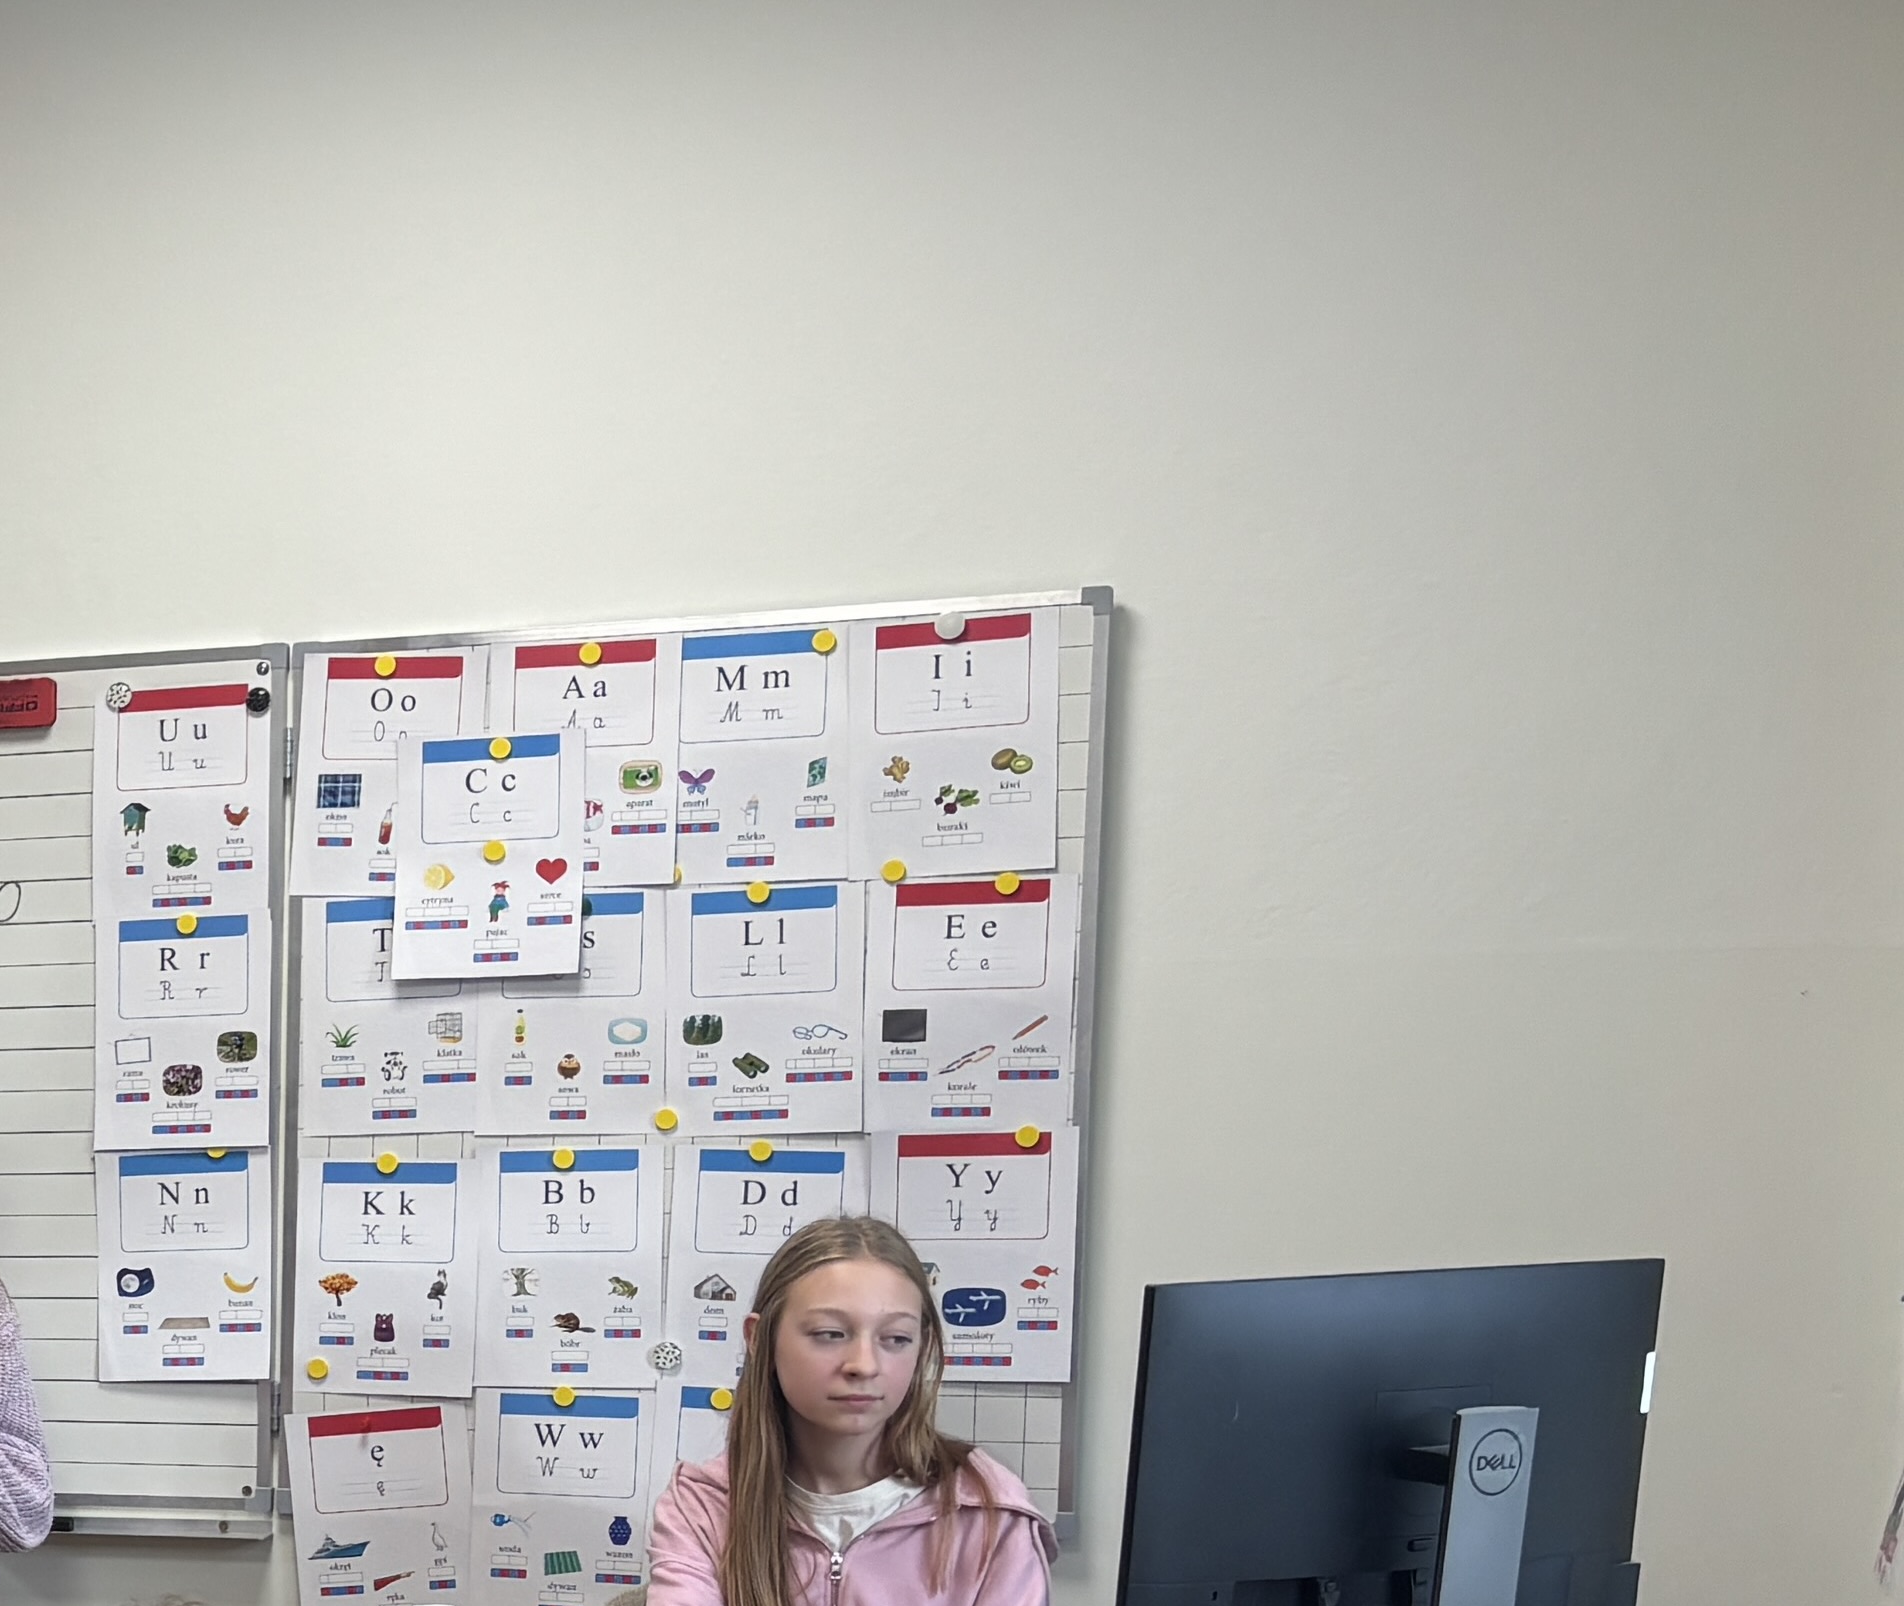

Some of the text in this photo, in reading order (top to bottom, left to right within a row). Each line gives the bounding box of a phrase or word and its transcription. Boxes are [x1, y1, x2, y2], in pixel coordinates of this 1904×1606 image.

[562, 675, 608, 699] A a
[715, 664, 790, 692] M m
[159, 948, 210, 971] R r
[158, 1182, 209, 1205] N n
[361, 1191, 415, 1215] K k
[542, 1179, 595, 1205] B b
[740, 1180, 798, 1206] D d
[534, 1423, 604, 1449] W w
[1476, 1454, 1516, 1471] DELL
